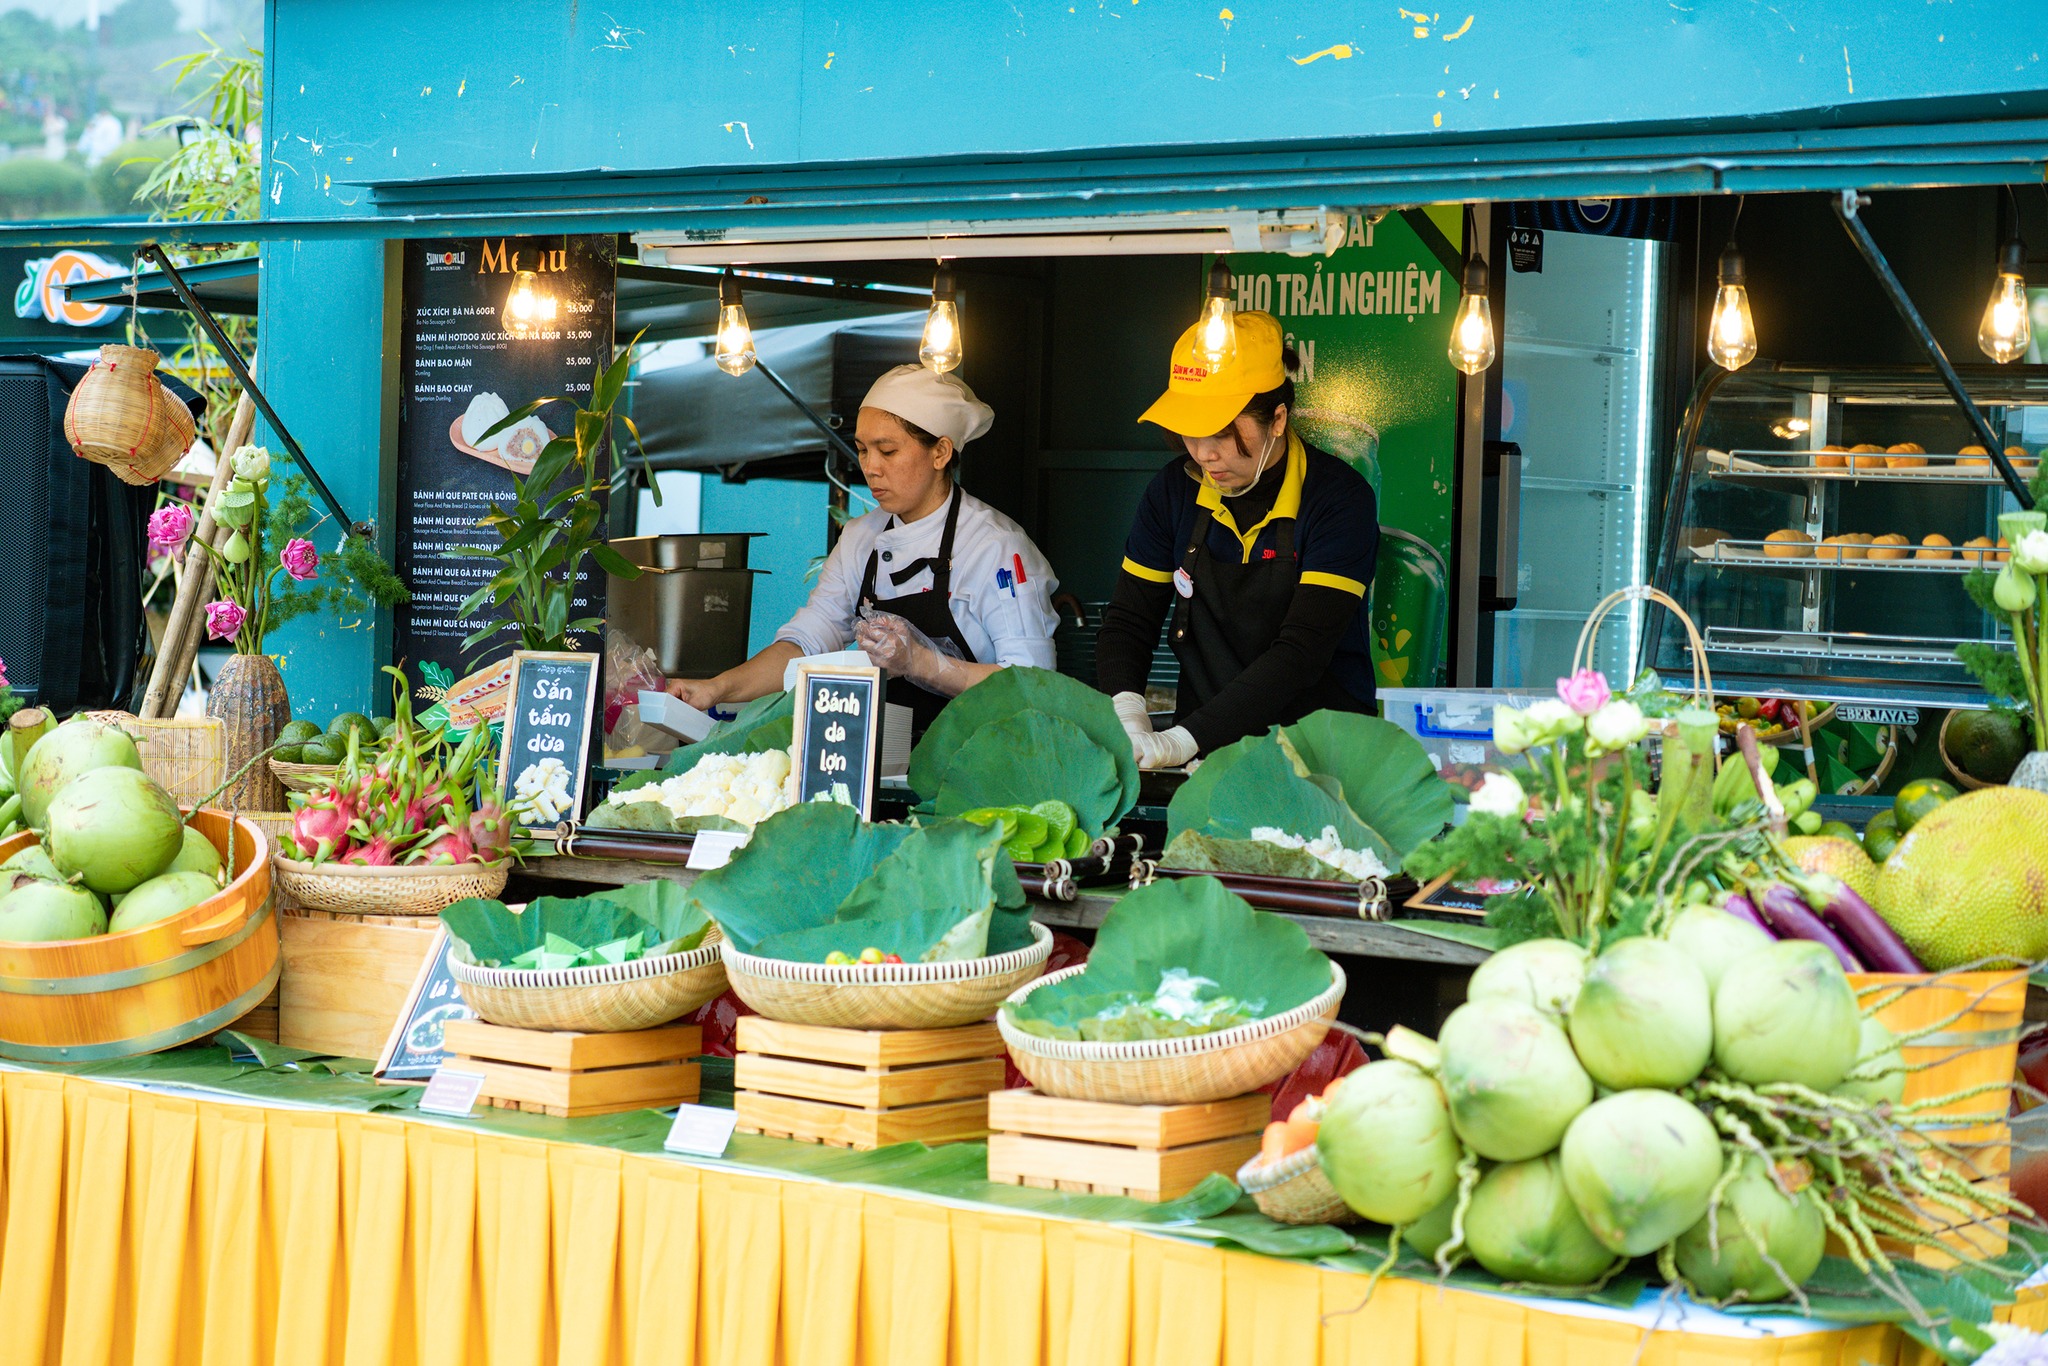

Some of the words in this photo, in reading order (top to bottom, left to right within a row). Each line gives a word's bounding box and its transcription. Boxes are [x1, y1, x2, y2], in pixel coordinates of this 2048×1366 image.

[1277, 261, 1334, 316] TRẢI
[1340, 263, 1441, 323] NGHIỆM
[416, 306, 432, 316] XÚC
[432, 306, 450, 316] XÍCH
[452, 306, 462, 315] BÀ
[464, 305, 475, 315] NÀ
[476, 307, 495, 315] 60GR
[568, 305, 592, 314] 35,000
[416, 332, 436, 342] BÁNH
[438, 332, 447, 341] MÌ
[449, 333, 480, 341] HOTDOG
[481, 331, 496, 340] XÚC
[542, 332, 560, 340] 80GR
[567, 331, 592, 340] 55,000
[416, 358, 436, 367] BÁNH
[438, 359, 453, 367] BAO
[454, 357, 472, 369] MẶN
[566, 357, 591, 366] 35,000
[415, 383, 436, 392] BÁNH
[437, 384, 452, 392] BAO
[454, 384, 473, 392] CHAY
[565, 384, 590, 392] 25,000
[414, 490, 434, 500] BÁNH
[435, 490, 444, 500] MÌ
[446, 492, 460, 500] QUE
[462, 492, 478, 500] PATE
[479, 490, 493, 500] CHÀ
[413, 515, 434, 525] BÁNH
[435, 515, 444, 525] MÌ
[445, 517, 460, 525] QUE
[461, 516, 476, 525] XÚC
[413, 541, 433, 550] BÁNH
[435, 541, 443, 550] MÌ
[413, 566, 432, 575] BÁNH
[434, 566, 443, 576] MÌ
[444, 568, 459, 576] QUE
[460, 567, 470, 576] GÀ
[472, 568, 481, 577] XÉ
[412, 591, 432, 601] BÁNH
[433, 592, 442, 601] MÌ
[444, 594, 458, 602] QUE
[411, 617, 431, 627] BÁNH
[433, 617, 442, 627] MÌ
[443, 619, 458, 628] QUE
[459, 618, 468, 628] CÁ
[533, 678, 572, 700] Sắn
[815, 688, 860, 716] Bánh
[528, 704, 571, 727] tẩm
[1846, 708, 1907, 723] BERJAYA
[824, 721, 846, 742] da
[527, 734, 565, 752] dừa
[820, 749, 846, 775] lợn
